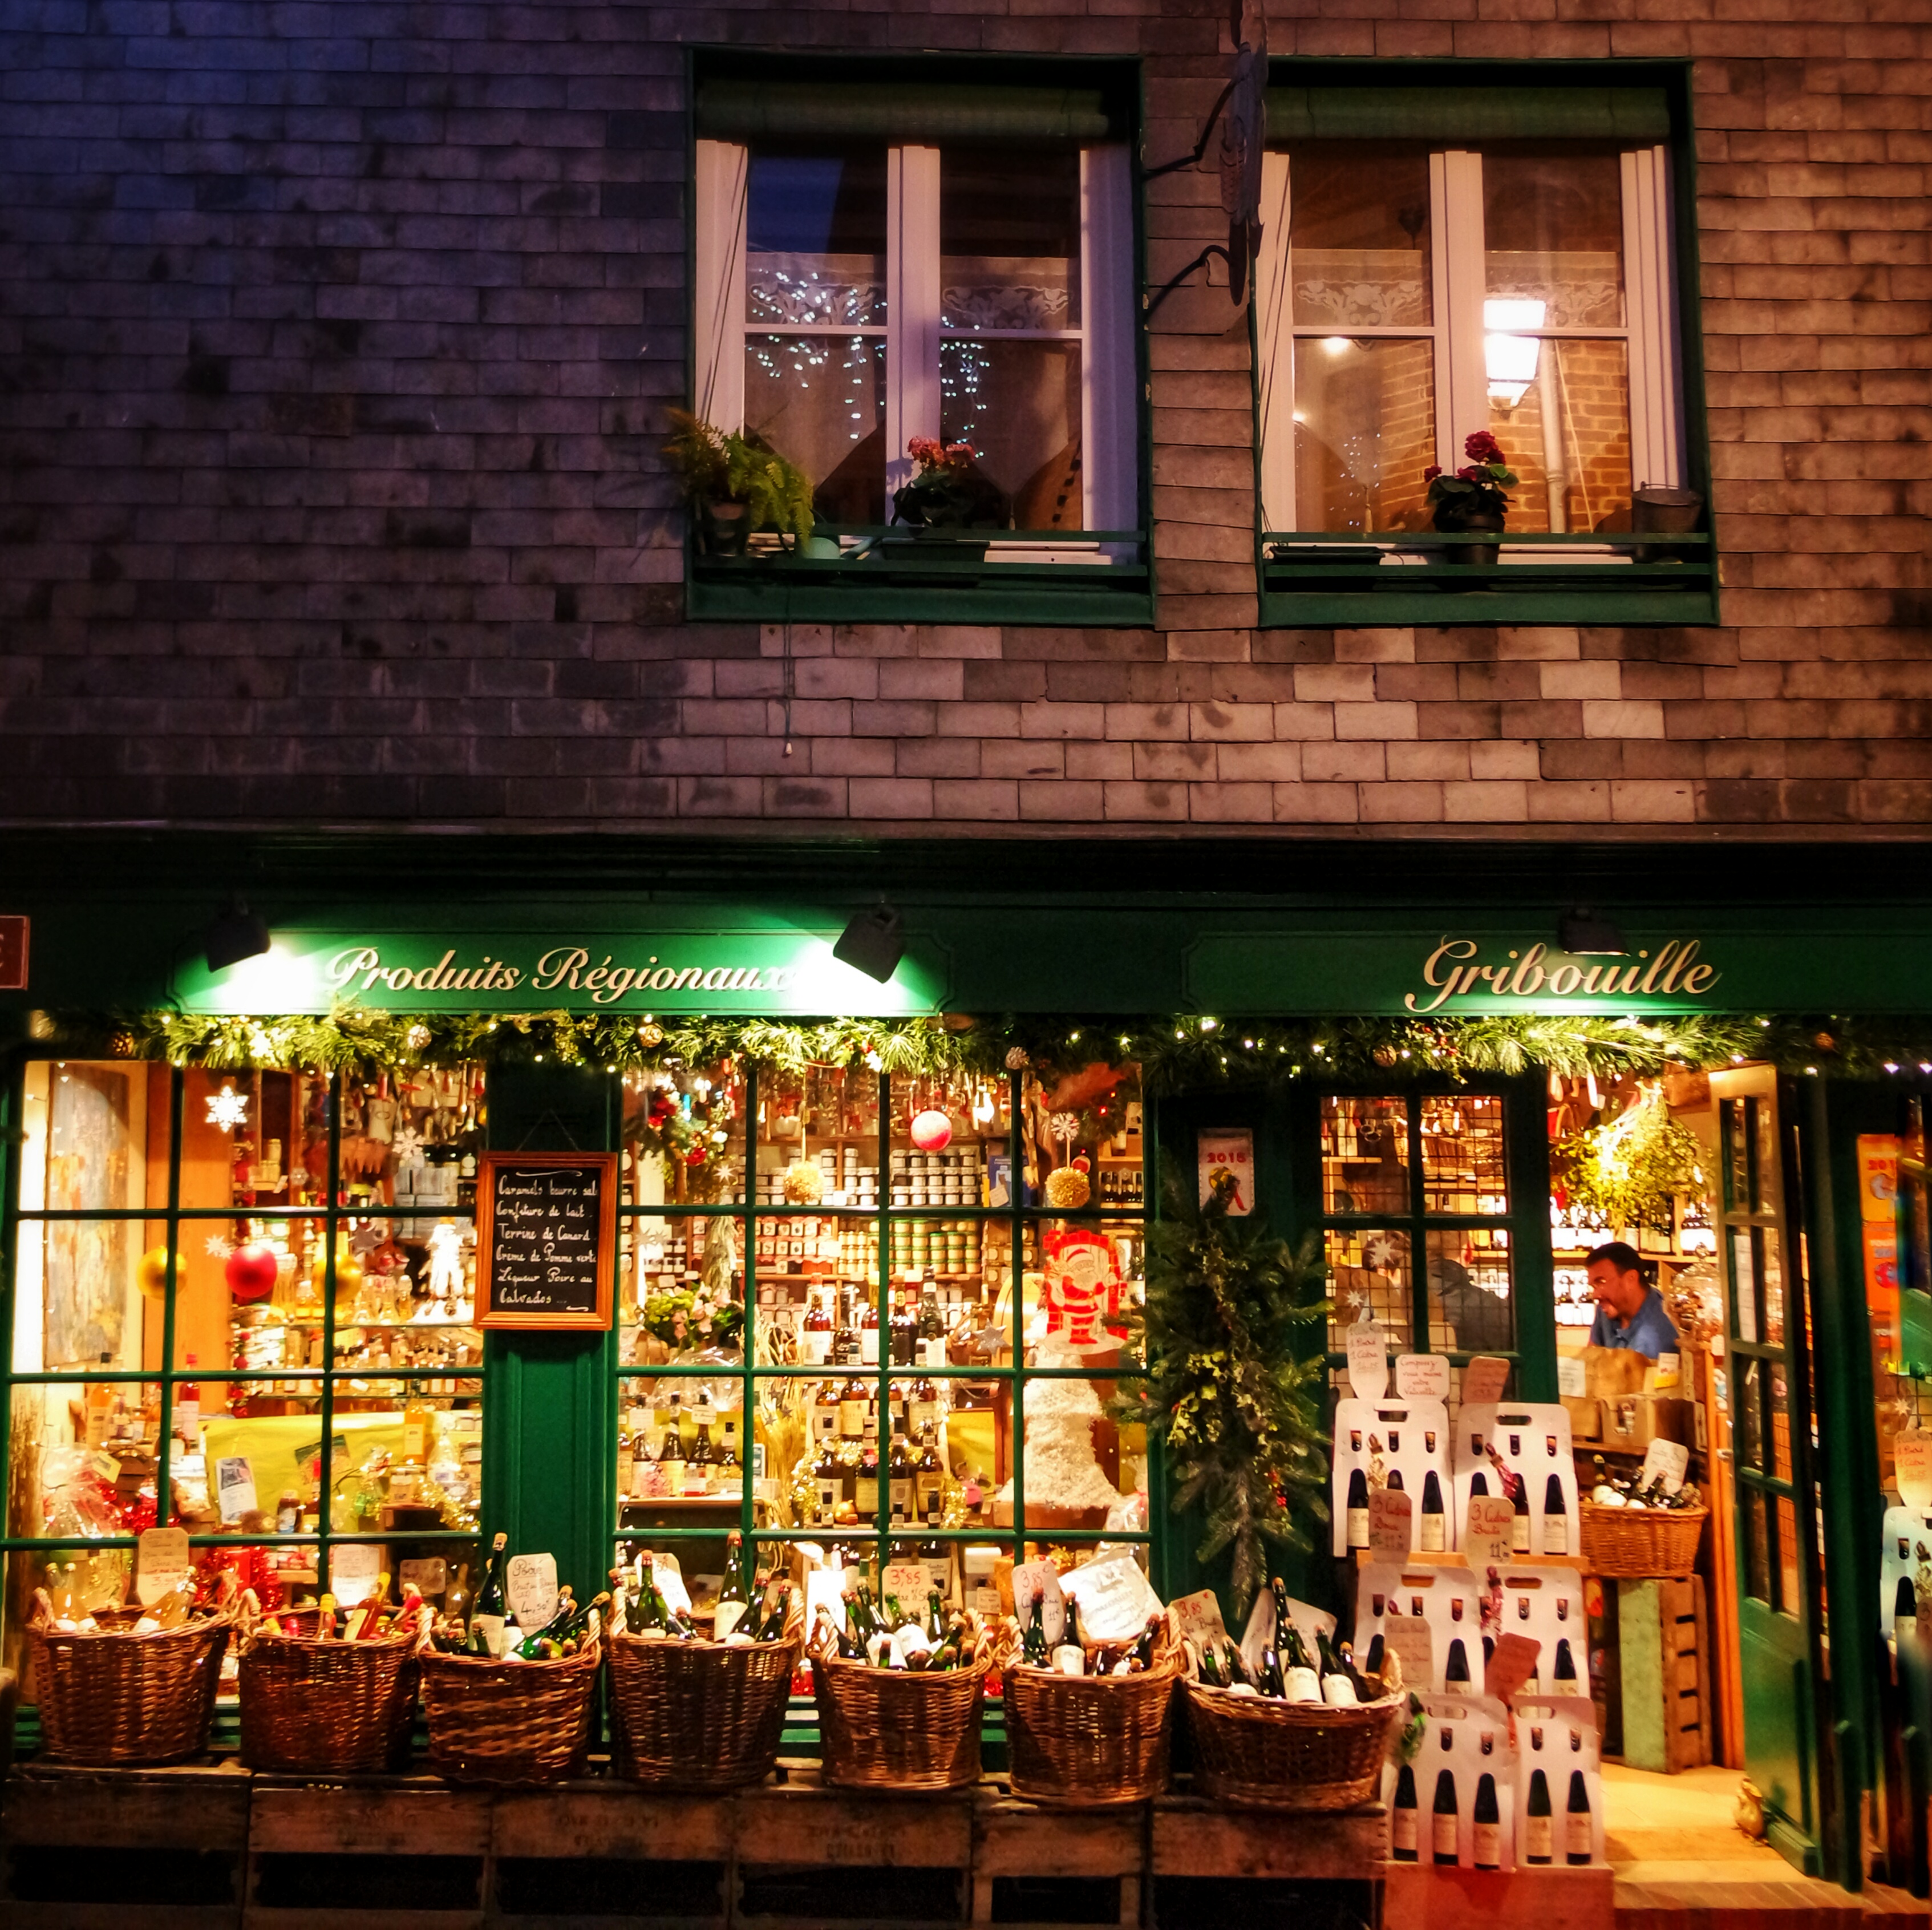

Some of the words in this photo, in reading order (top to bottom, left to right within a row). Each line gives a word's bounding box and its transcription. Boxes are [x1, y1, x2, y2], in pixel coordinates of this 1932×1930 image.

[326, 946, 528, 990] Produits
[532, 946, 797, 1004] Régionaux
[1405, 934, 1722, 1013] Gribouille
[499, 1175, 543, 1195] Caramels
[549, 1179, 578, 1195] beurre
[582, 1180, 598, 1196] sal
[496, 1200, 544, 1223] Confiture
[548, 1204, 560, 1217] de
[497, 1223, 537, 1240] Terrine
[542, 1227, 554, 1240] de
[557, 1224, 591, 1241] Canard
[496, 1244, 526, 1261] Crème
[530, 1249, 541, 1262] de
[543, 1242, 573, 1263] Pomme
[497, 1266, 541, 1287] Liqueur
[546, 1267, 576, 1282] Poire
[500, 1287, 552, 1304] Calvados
